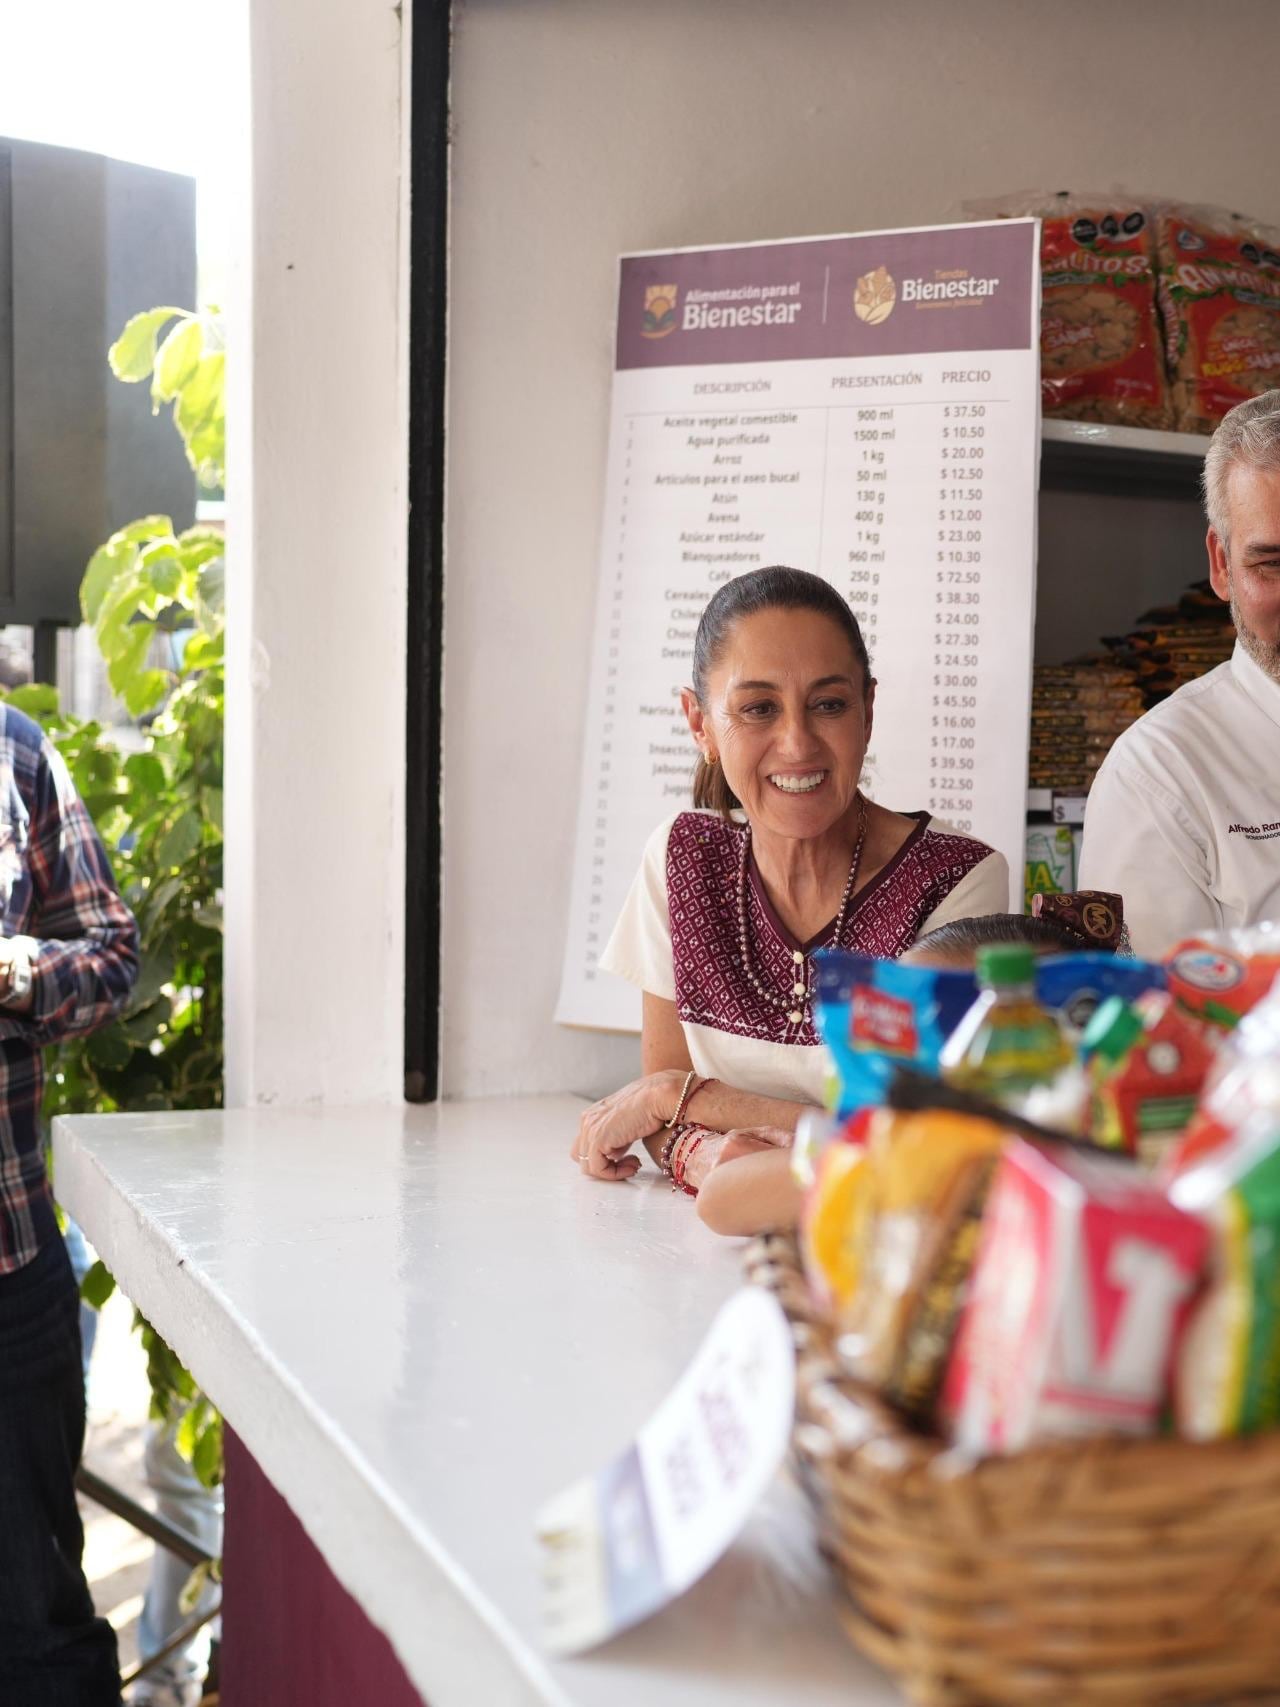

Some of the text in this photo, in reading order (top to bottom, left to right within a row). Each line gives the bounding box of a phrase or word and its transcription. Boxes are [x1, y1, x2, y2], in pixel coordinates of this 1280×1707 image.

[685, 282, 800, 303] Alimentación para el
[901, 276, 1000, 302] Bienestar
[682, 301, 802, 330] Bienestar
[831, 371, 924, 389] PRESENTACIÓN
[941, 370, 992, 384] PRECIO
[693, 379, 772, 395] DESCRIPCIÓN
[858, 409, 893, 421] 900 ml
[944, 405, 985, 417] $ 37.50
[664, 412, 798, 429] Aceite vegetal comestible
[854, 429, 895, 441] 1500 ml
[943, 426, 984, 438] $ 10.50
[687, 433, 770, 449] Agua purificada
[713, 454, 742, 464] Arroz
[863, 450, 884, 464] 1 kg
[942, 447, 984, 459] $ 20.00
[704, 476, 728, 486] para
[769, 472, 799, 483] bucal
[857, 470, 886, 482] 50 ml
[941, 468, 983, 480] $ 12.50
[857, 490, 885, 505] 130 g
[940, 489, 982, 500] $ 11.50
[707, 512, 740, 523] Avena
[855, 511, 883, 525] 400 g
[939, 509, 982, 521] $ 12.00
[679, 532, 765, 543] Azúcar estándar
[858, 531, 880, 545] 1 kg
[938, 530, 981, 542] $ 23.00
[682, 551, 760, 564] Blanqueadores
[849, 551, 885, 562] 960 ml
[937, 551, 981, 563] $ 10.30
[708, 570, 732, 584] Café
[850, 571, 879, 585] 250 g
[937, 571, 980, 584] $ 72.50
[870, 592, 879, 606] g
[936, 592, 980, 604] $ 38.30
[936, 613, 979, 625] $ 24.00
[935, 634, 979, 646] $ 27.30
[935, 654, 978, 666] $ 24.50
[934, 675, 977, 687] $ 30.00
[933, 695, 976, 708] $ 45.50
[932, 716, 975, 728] $ 16.00
[932, 736, 975, 749] $ 17.00
[931, 757, 974, 770] $ 39.50
[930, 777, 973, 790] $ 22.50
[929, 798, 972, 811] $ 26.50
[1055, 806, 1065, 820] $
[1228, 823, 1261, 834] Alfredo
